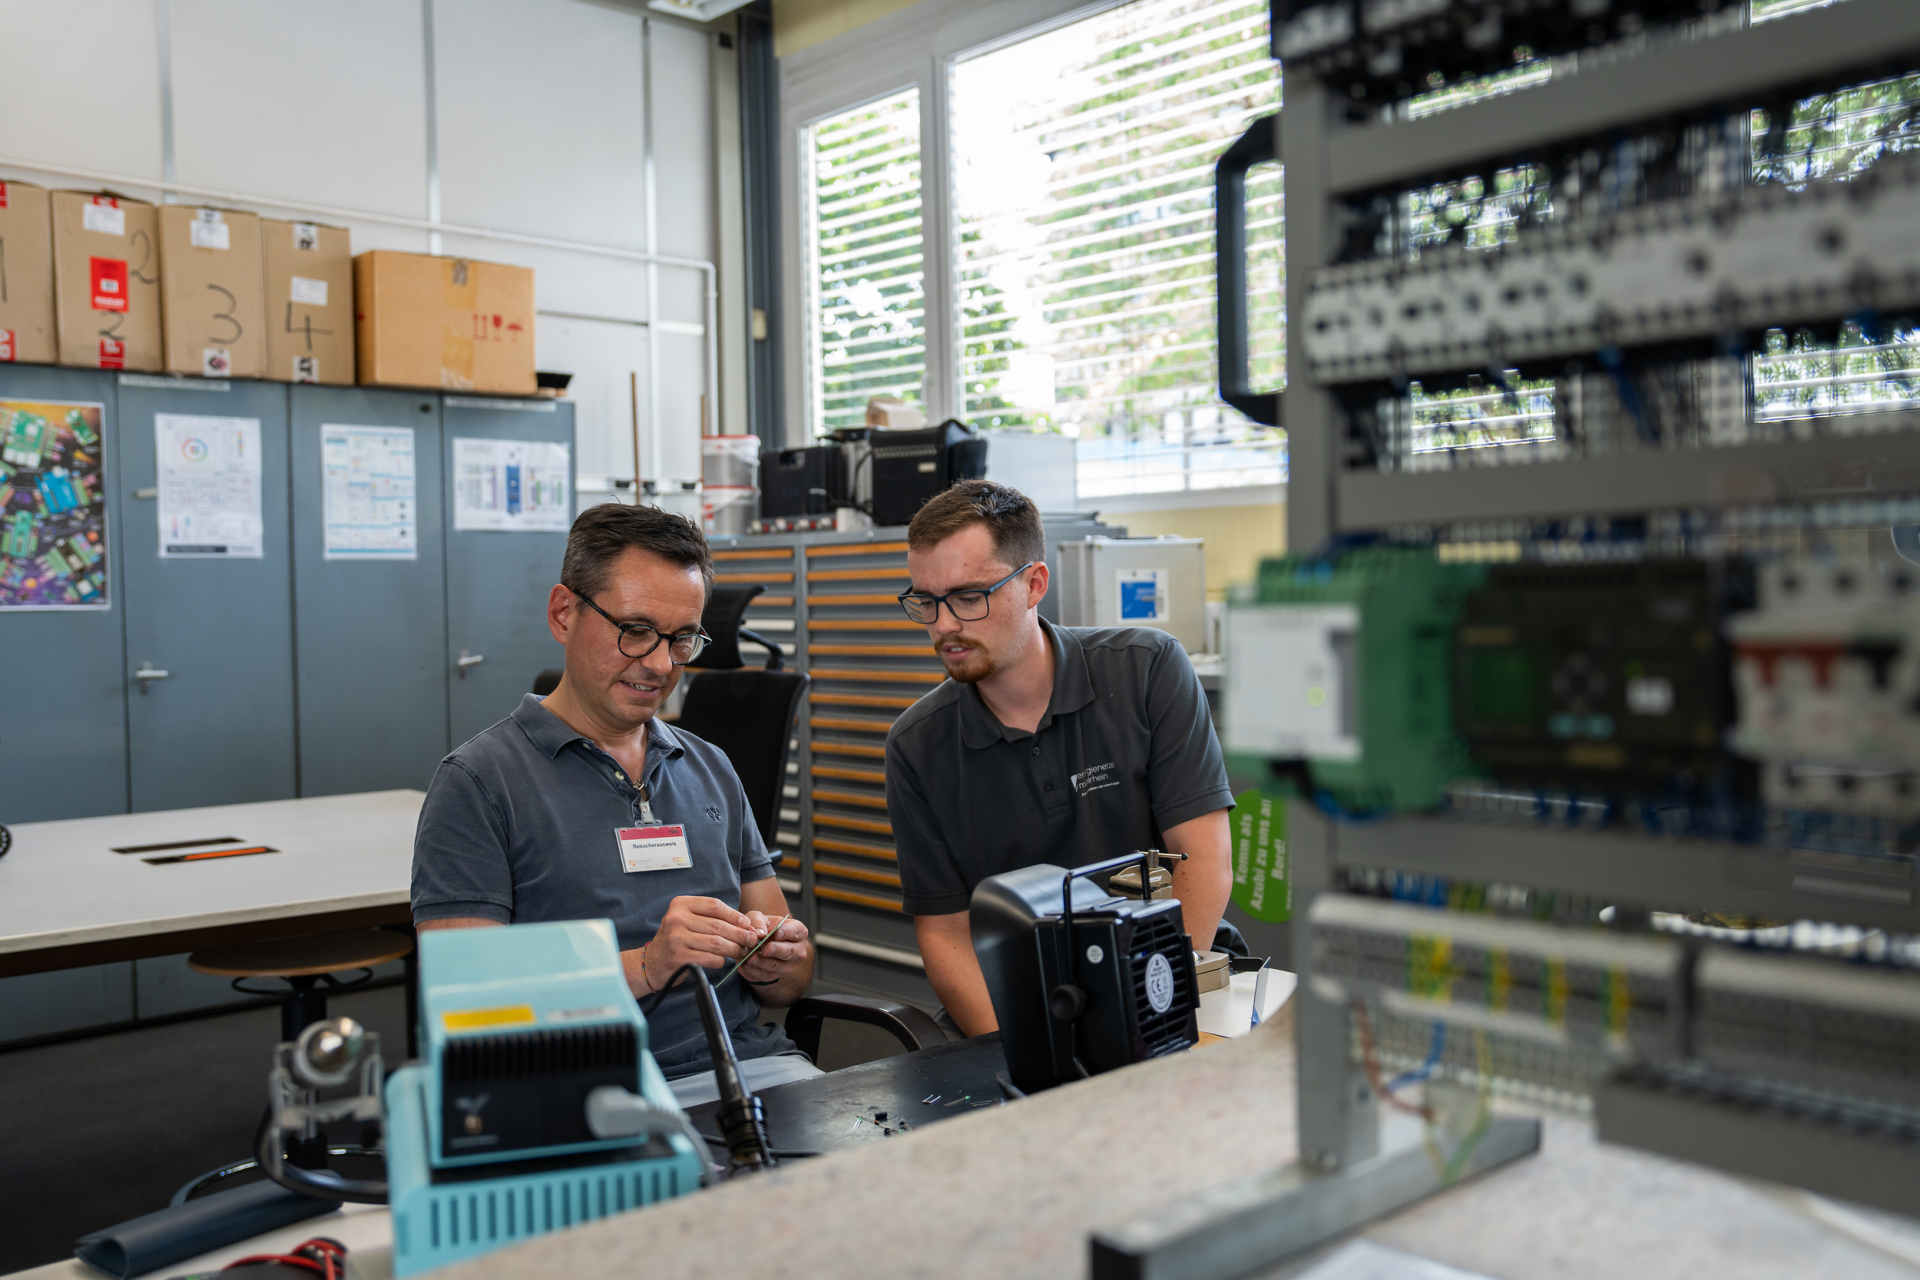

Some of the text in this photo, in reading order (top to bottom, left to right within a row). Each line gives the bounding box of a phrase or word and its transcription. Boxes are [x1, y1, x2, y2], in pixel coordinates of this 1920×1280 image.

[130, 229, 158, 284] 2
[99, 311, 126, 341] 2
[206, 283, 243, 345] 3
[285, 301, 334, 352] 4
[632, 841, 677, 849] Besucherausweis
[1235, 813, 1252, 884] Komm als
[1258, 819, 1270, 846] uns
[1256, 848, 1268, 867] zu
[1250, 867, 1265, 911] Azubi
